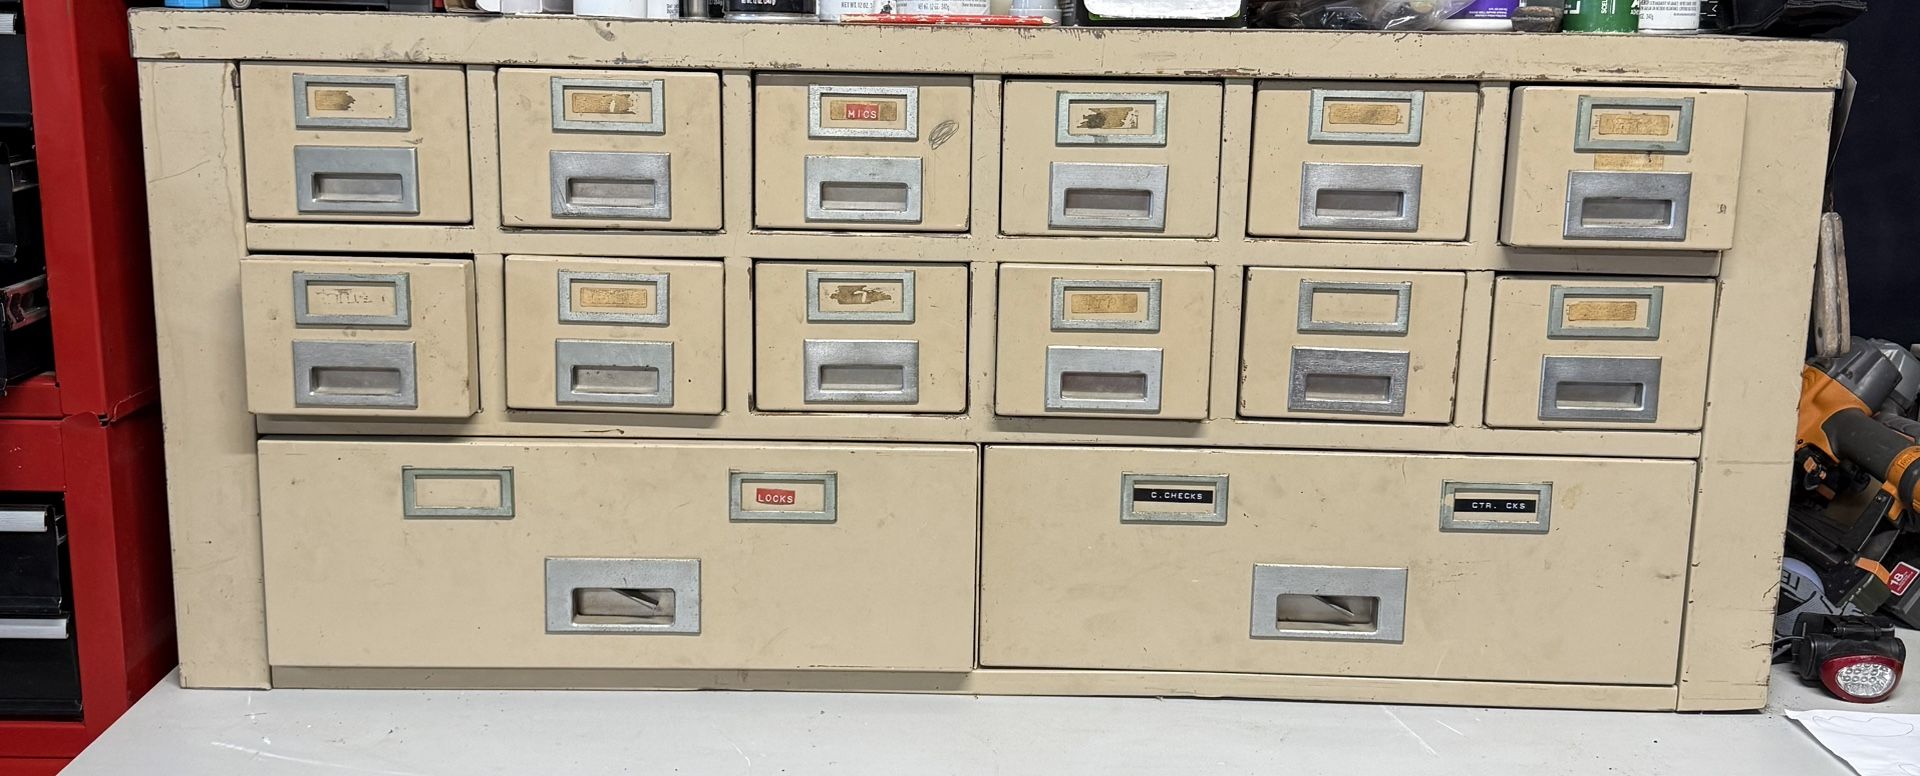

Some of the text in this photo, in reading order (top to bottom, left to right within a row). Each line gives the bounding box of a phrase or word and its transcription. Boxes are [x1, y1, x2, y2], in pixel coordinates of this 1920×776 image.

[847, 110, 877, 119] MICS
[758, 494, 793, 504] LOCKS
[1151, 491, 1203, 500] C.CHECKS
[1505, 502, 1526, 510] CKS
[1890, 572, 1904, 585] 18
